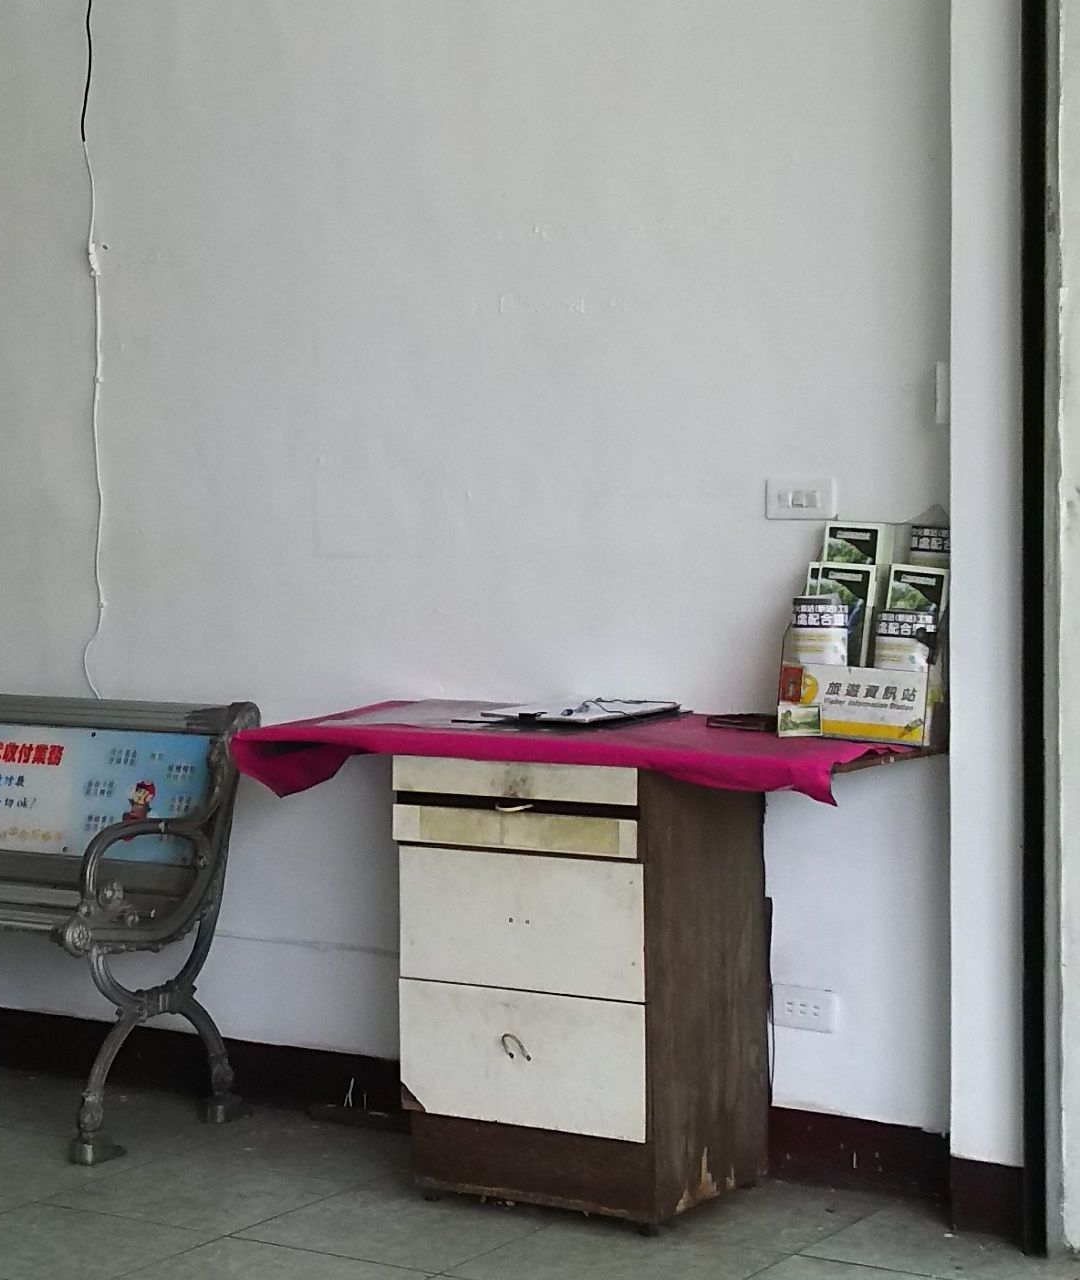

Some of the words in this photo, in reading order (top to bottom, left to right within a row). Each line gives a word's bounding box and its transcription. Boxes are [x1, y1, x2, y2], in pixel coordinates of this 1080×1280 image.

[825, 681, 919, 702] 旅遊資訊站
